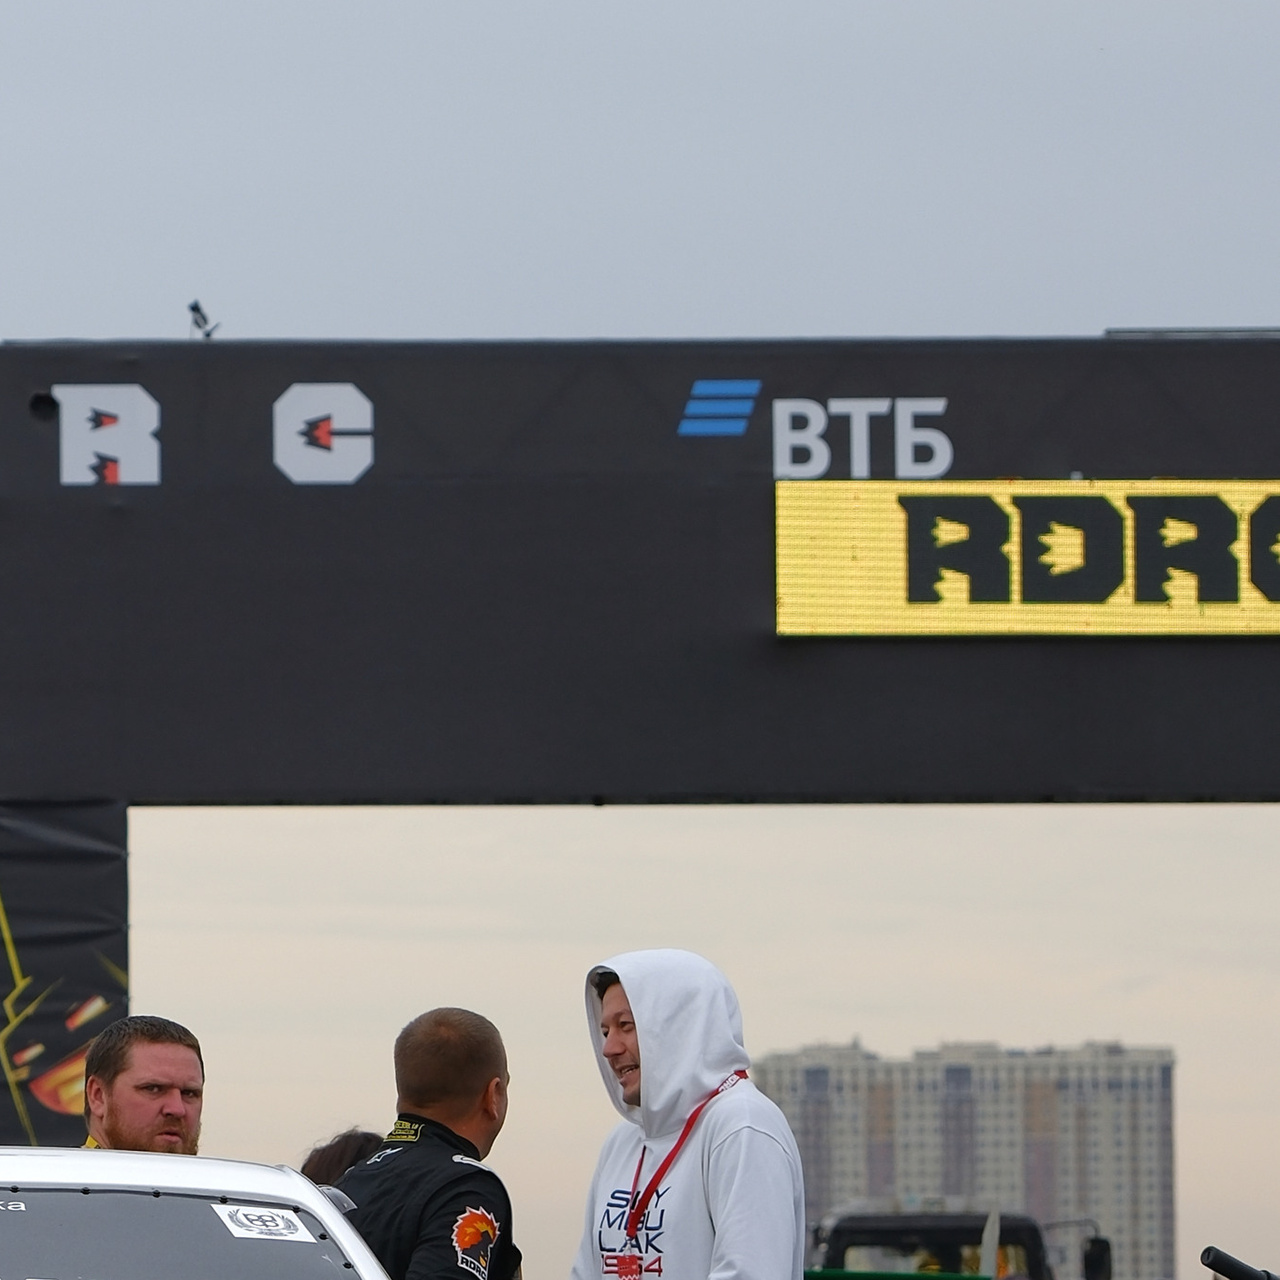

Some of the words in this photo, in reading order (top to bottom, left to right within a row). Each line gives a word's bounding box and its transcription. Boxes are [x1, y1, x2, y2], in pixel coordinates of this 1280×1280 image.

[771, 396, 956, 480] ВТБ
[598, 1230, 665, 1254] LAK
[460, 1257, 487, 1280] RDRC
